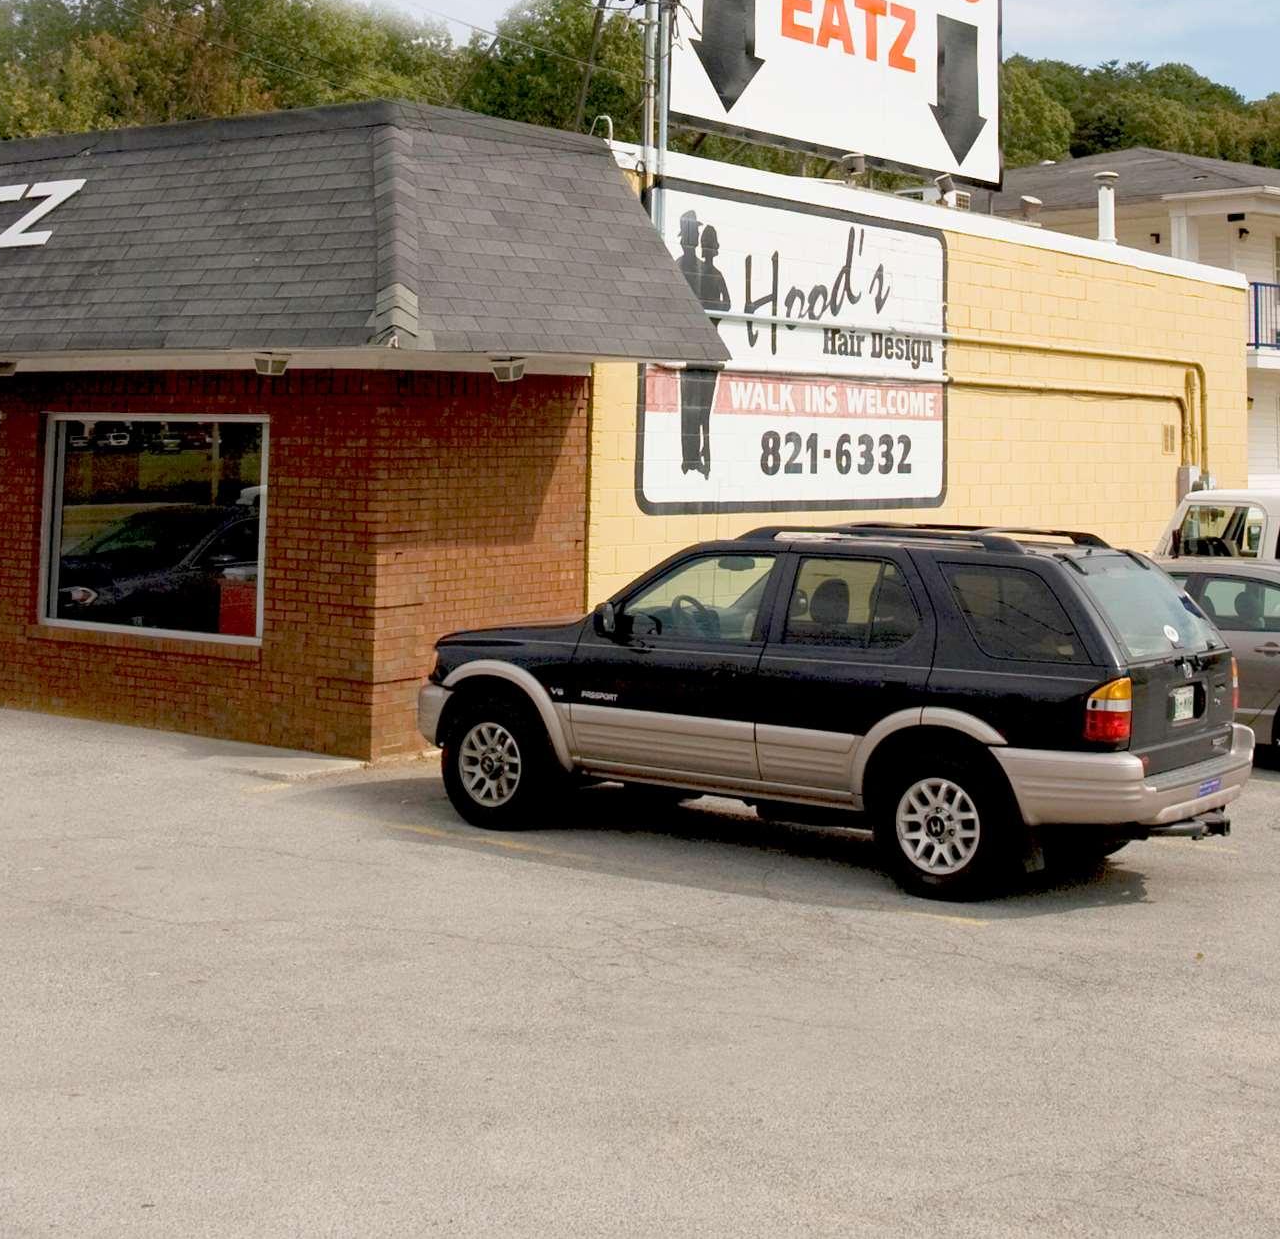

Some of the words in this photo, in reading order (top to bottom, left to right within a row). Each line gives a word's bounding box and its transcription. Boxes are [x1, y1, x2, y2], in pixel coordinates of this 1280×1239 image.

[744, 226, 892, 356] Hood's
[822, 328, 866, 358] Hair
[870, 333, 934, 369] Design
[729, 380, 798, 413] WALK
[803, 385, 839, 414] INS
[845, 387, 937, 417] WELCOME
